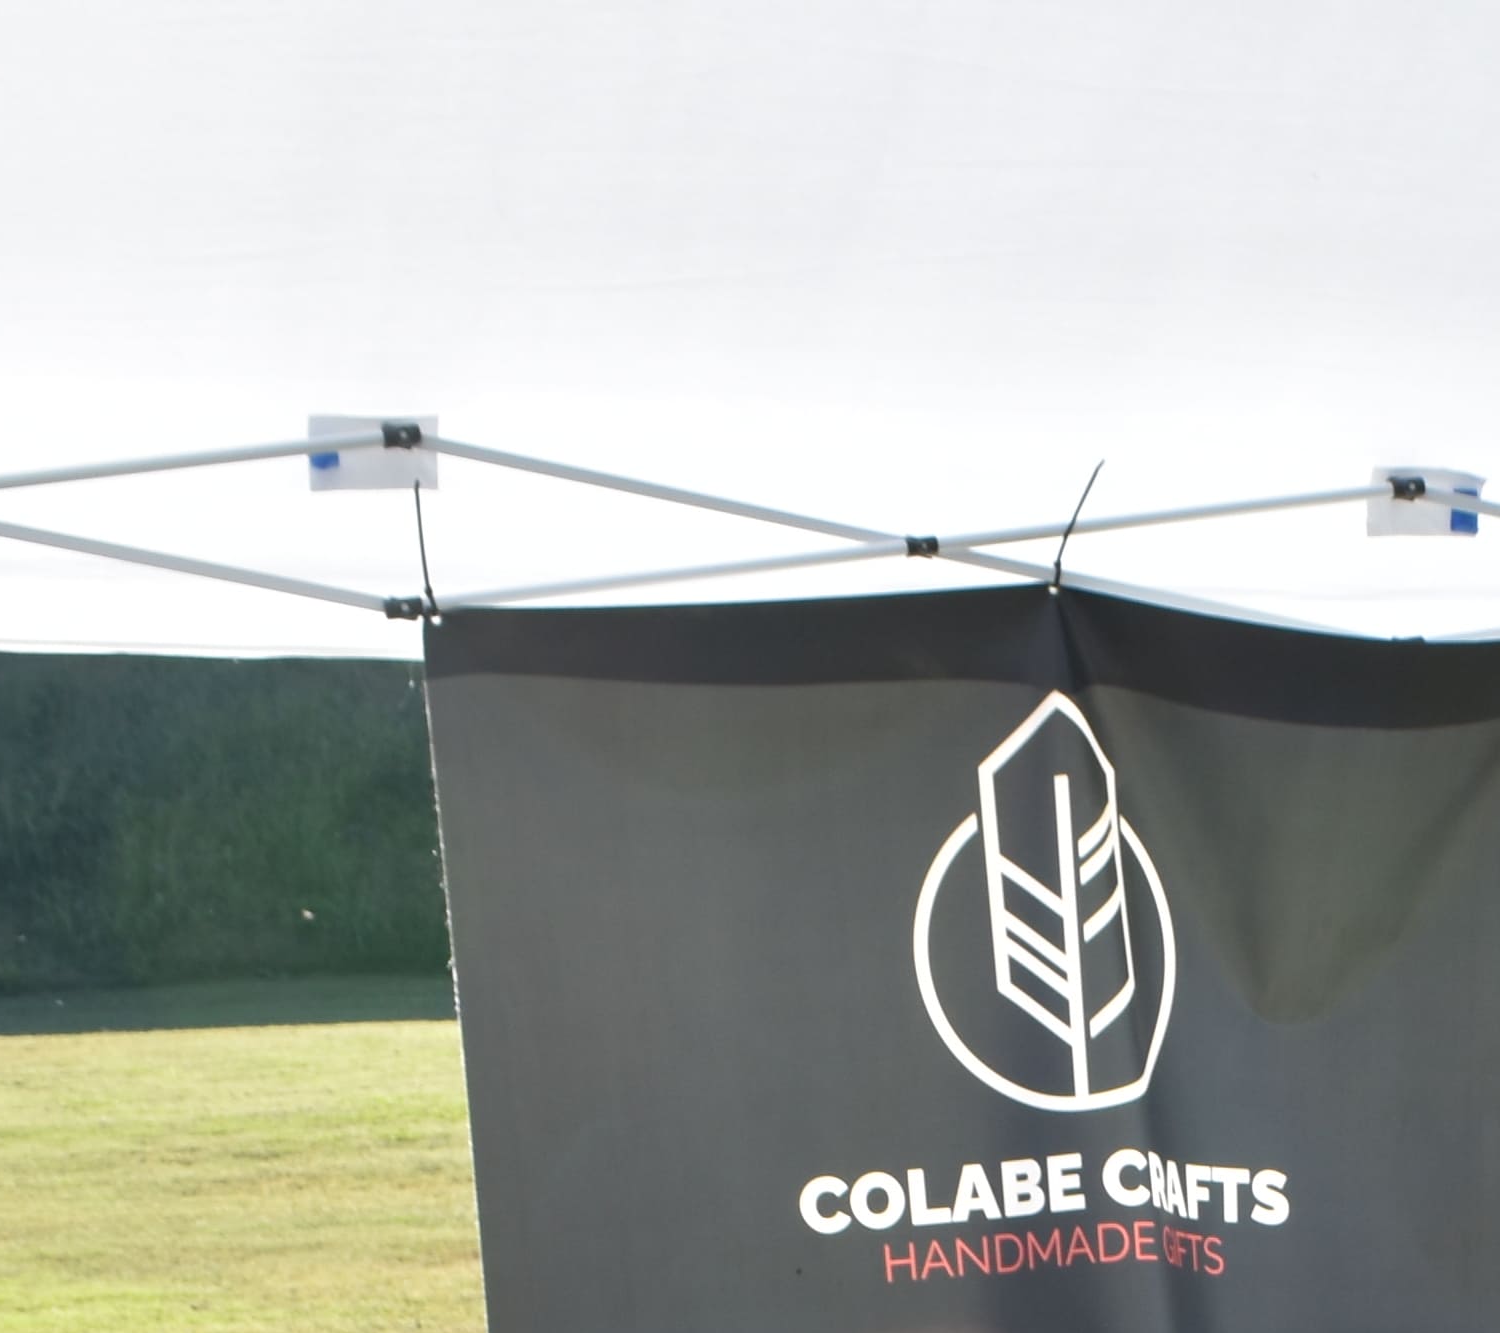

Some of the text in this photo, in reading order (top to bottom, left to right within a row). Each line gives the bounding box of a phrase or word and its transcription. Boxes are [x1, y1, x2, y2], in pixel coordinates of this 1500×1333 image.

[799, 1148, 1291, 1235] COLABE CRAFTS
[883, 1220, 1226, 1284] HANDMADE GIFTS
